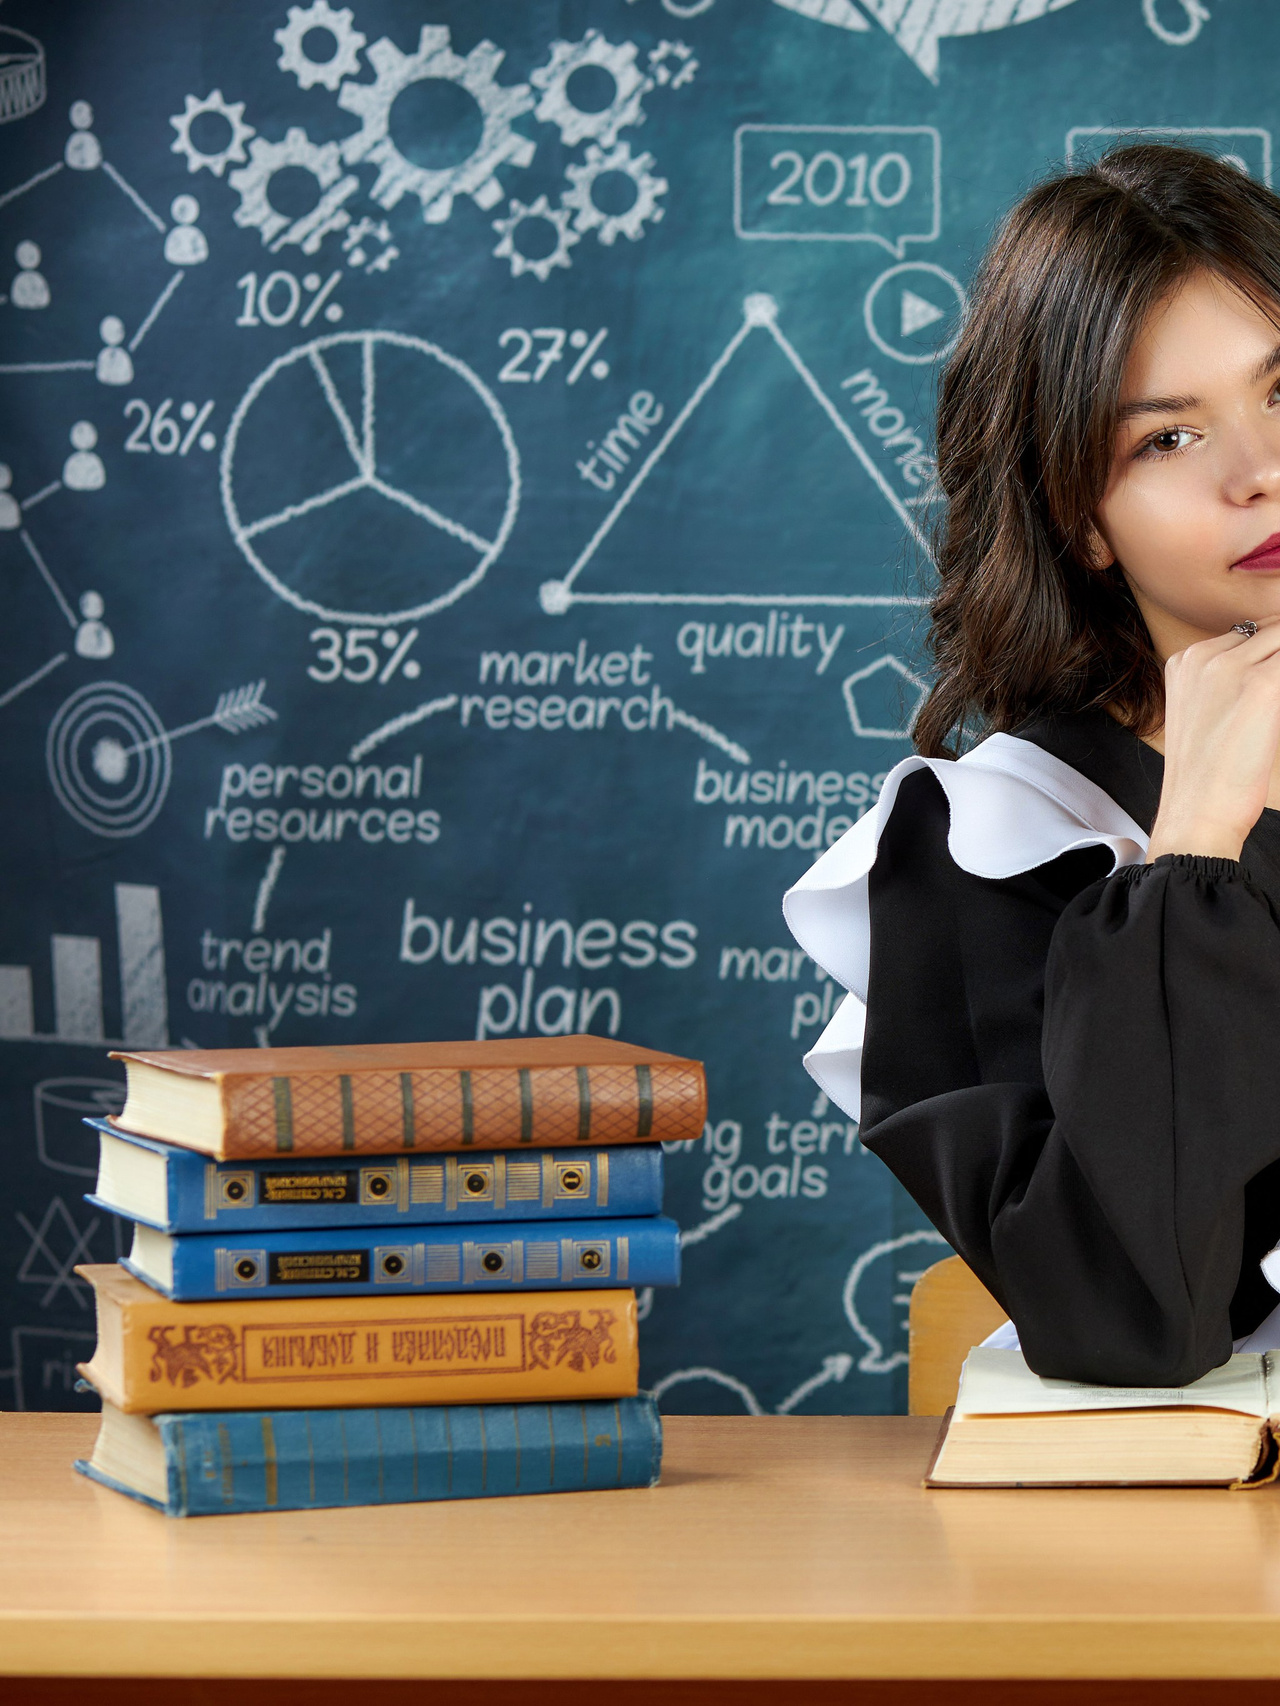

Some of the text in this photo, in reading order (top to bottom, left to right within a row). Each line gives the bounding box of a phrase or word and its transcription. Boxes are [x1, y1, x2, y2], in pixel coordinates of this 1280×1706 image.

[767, 151, 911, 207] 2010
[236, 271, 343, 327] 10%
[499, 328, 609, 384] 27%
[124, 399, 217, 455] 26%
[577, 390, 664, 491] time
[308, 628, 421, 683] 35%
[479, 640, 653, 686] market
[678, 611, 845, 675] quality
[461, 685, 675, 730] research
[219, 753, 423, 809] personal
[204, 806, 441, 844] resources
[723, 805, 866, 850] mode
[200, 927, 332, 973] trend
[400, 897, 698, 969] business
[718, 946, 829, 981] mar
[187, 971, 358, 1031] analysis
[475, 966, 621, 1041] plan
[791, 980, 847, 1040] pl
[661, 1119, 742, 1166] ng
[702, 1155, 829, 1211] goals
